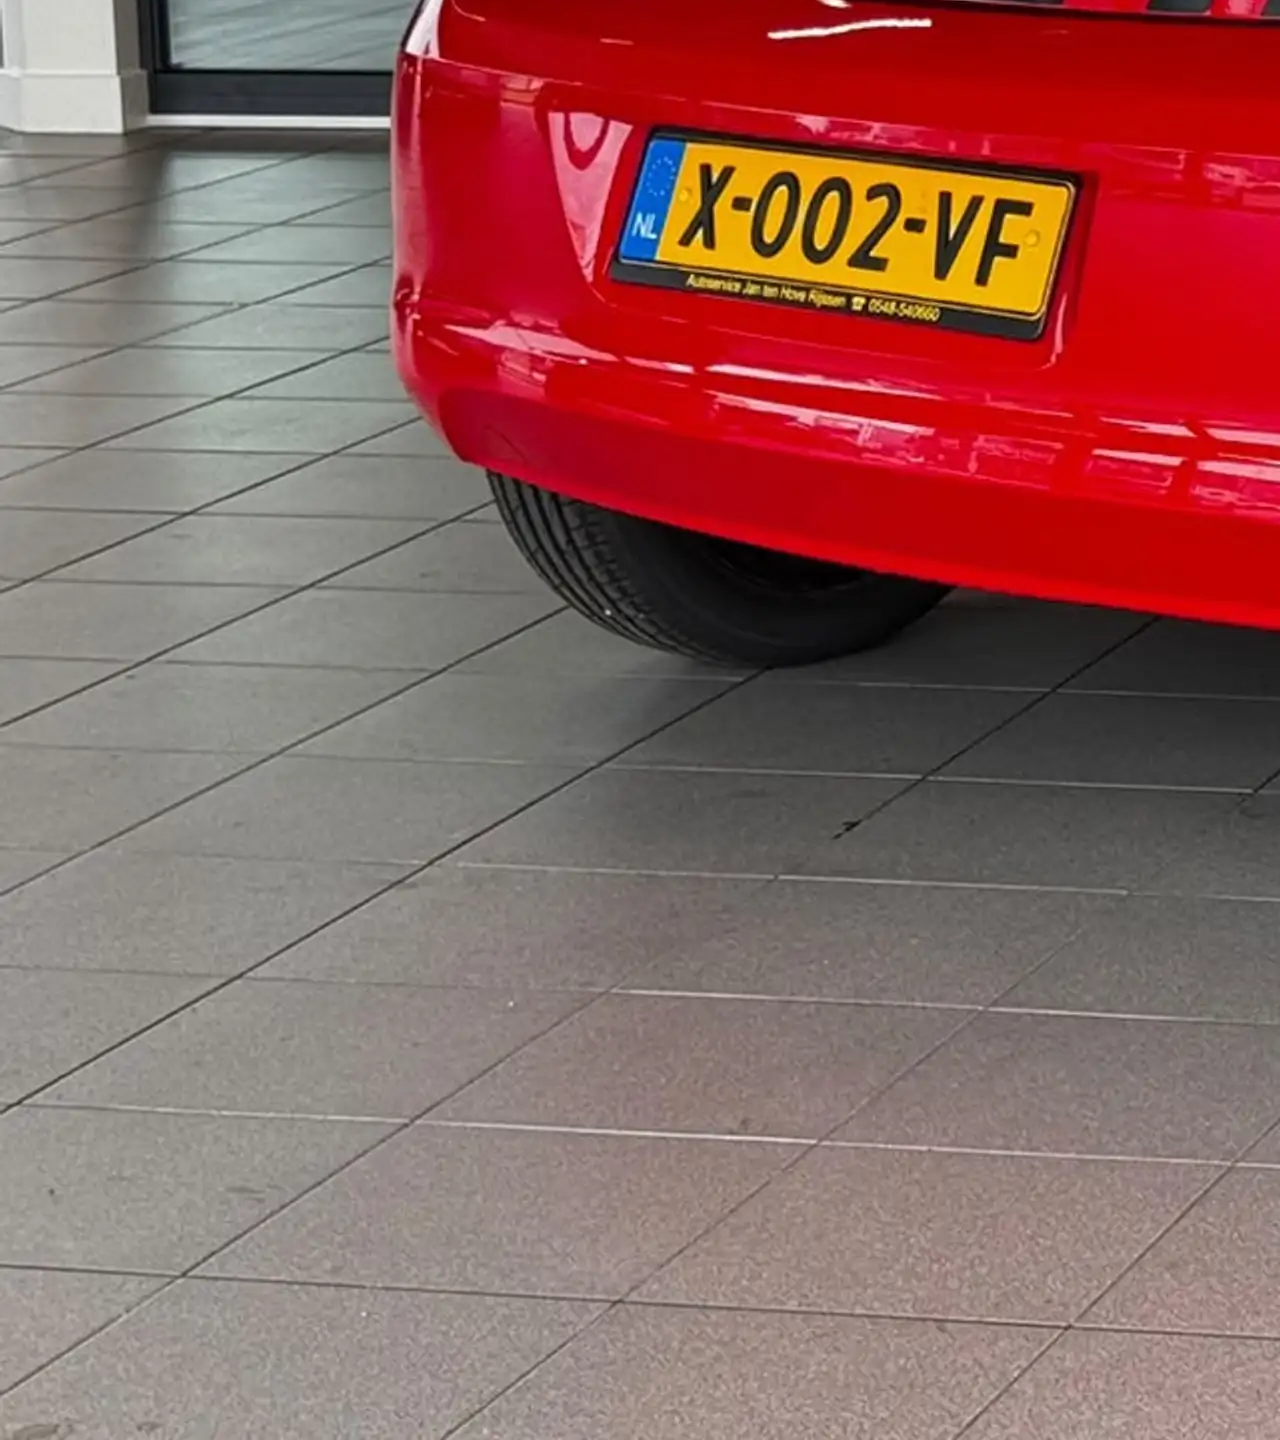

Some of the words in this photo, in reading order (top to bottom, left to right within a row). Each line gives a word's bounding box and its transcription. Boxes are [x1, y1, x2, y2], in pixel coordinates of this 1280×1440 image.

[631, 211, 659, 240] NL
[677, 162, 1034, 287] X-002-VF
[686, 273, 742, 294] Autoservice
